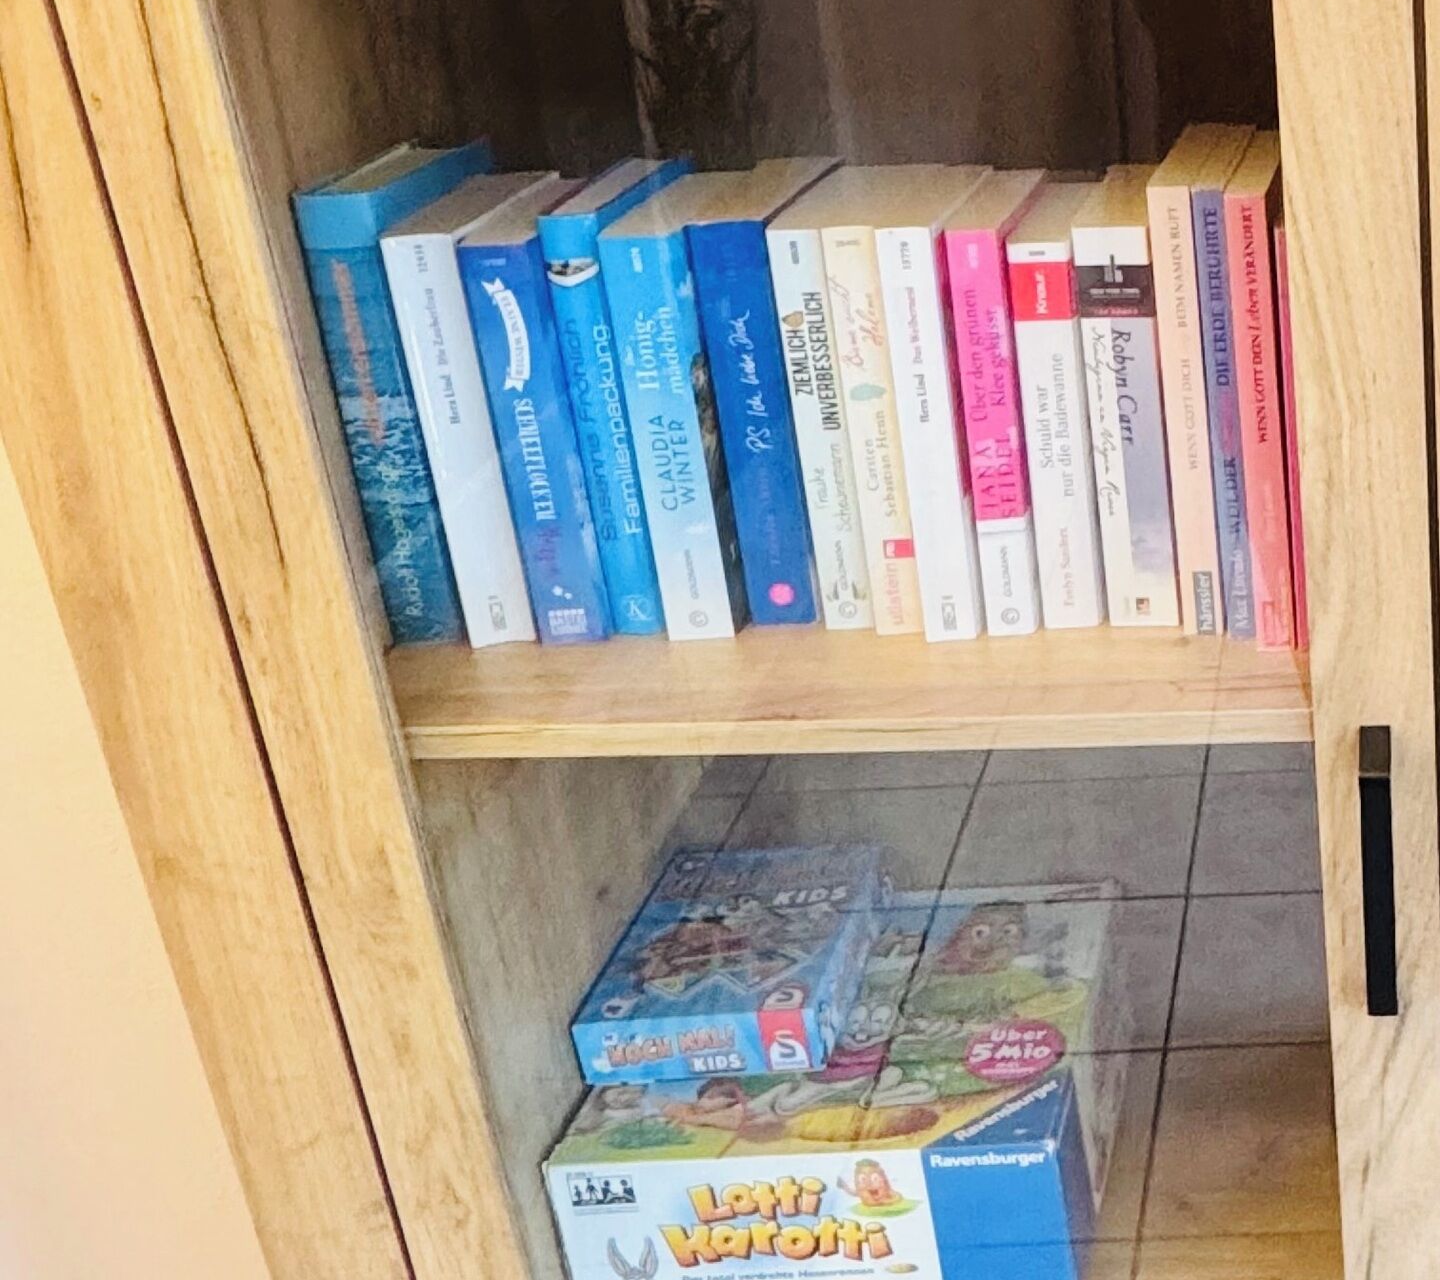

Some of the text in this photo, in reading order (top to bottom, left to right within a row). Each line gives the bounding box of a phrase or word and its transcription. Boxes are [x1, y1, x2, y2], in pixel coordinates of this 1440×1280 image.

[1170, 243, 1185, 293] NAMEN
[786, 329, 815, 397] ZIEMLICH
[802, 291, 842, 432] UNVERBESSERLICH
[1105, 326, 1136, 389] Robyn
[1180, 358, 1193, 392] DICH
[1253, 368, 1267, 401] GOTT
[592, 324, 644, 536] Familienpackung
[1117, 393, 1141, 446] Carr
[1257, 403, 1270, 443] WENN
[649, 414, 679, 512] CLAUDIA
[669, 419, 696, 506] WINTER
[1055, 441, 1073, 470] die
[1061, 472, 1076, 498] nur
[773, 885, 848, 906] KIDS
[690, 1053, 743, 1073] KIDS
[968, 1042, 1052, 1064] 5 Mio
[952, 1080, 1059, 1142] Ravensburger
[930, 1151, 1046, 1168] Ravensburger
[686, 1175, 828, 1223] Lotti
[658, 1215, 894, 1269] Karotti
